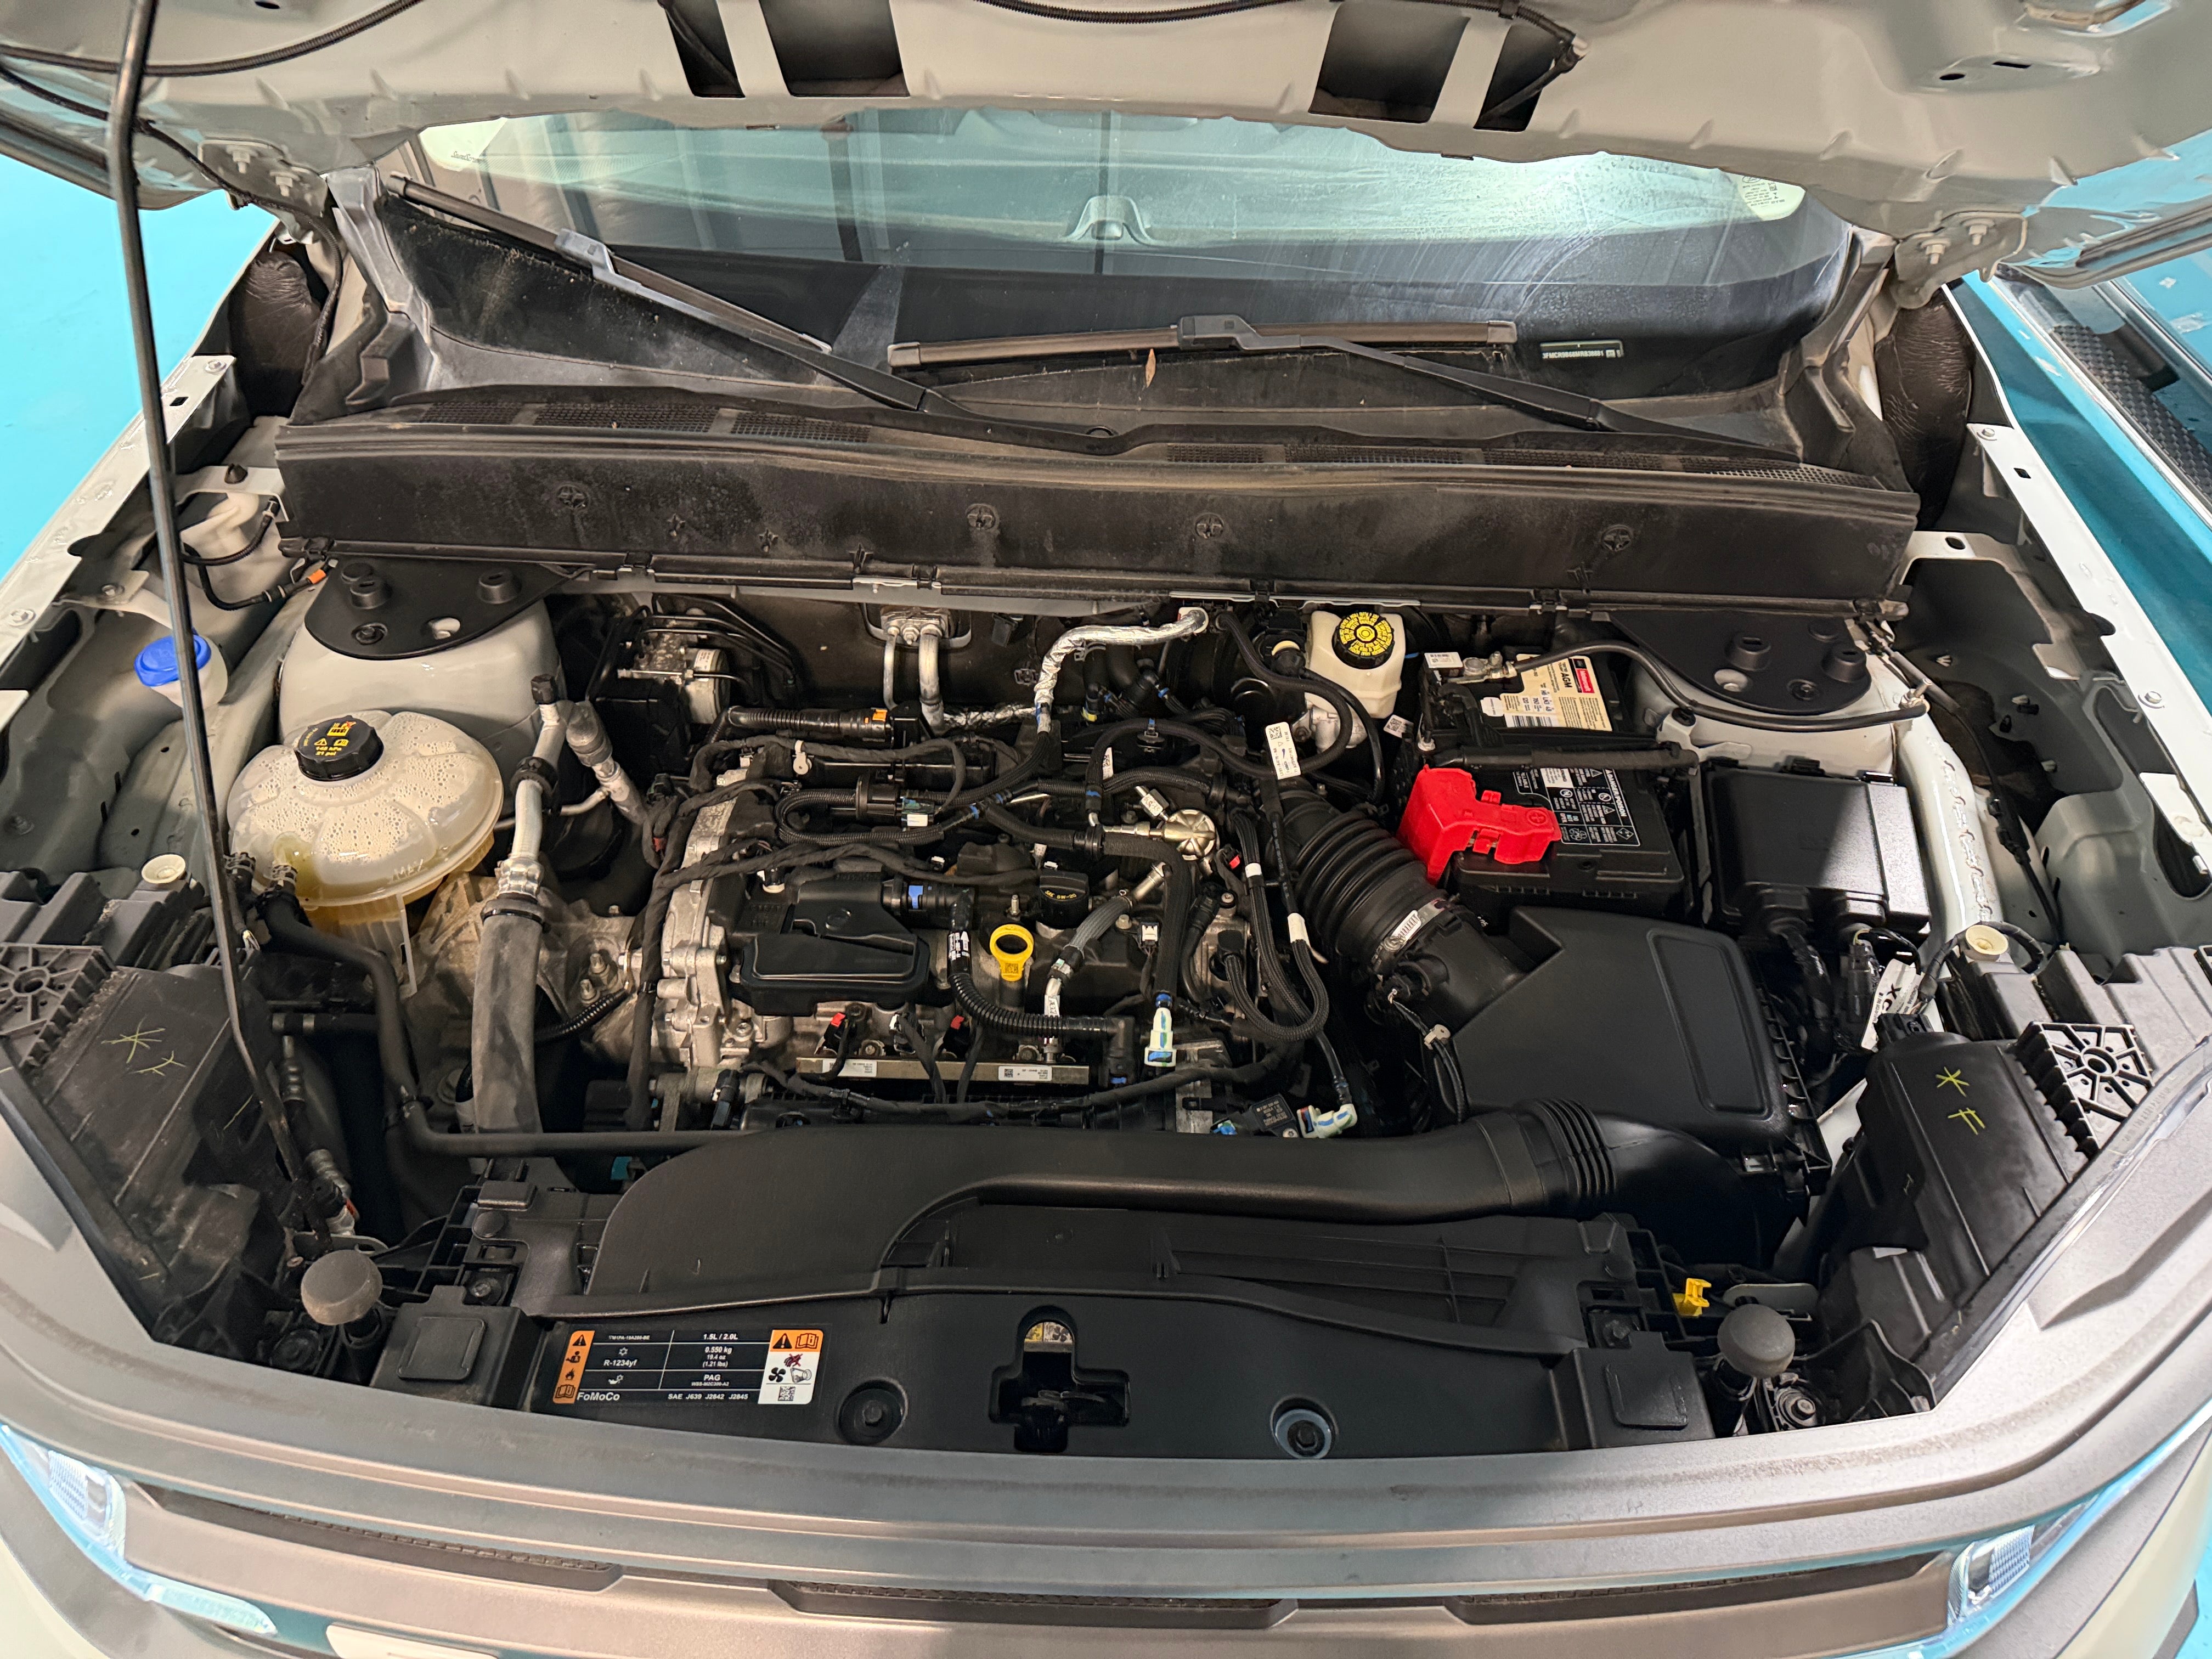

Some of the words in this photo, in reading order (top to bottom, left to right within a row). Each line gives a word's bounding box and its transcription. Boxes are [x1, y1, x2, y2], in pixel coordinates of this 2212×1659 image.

[1560, 672, 1573, 688] AGM
[1045, 890, 1056, 898] SAE
[724, 1346, 732, 1355] kg
[603, 1359, 637, 1368] R-1234yf
[576, 1391, 620, 1401] FoMoCo
